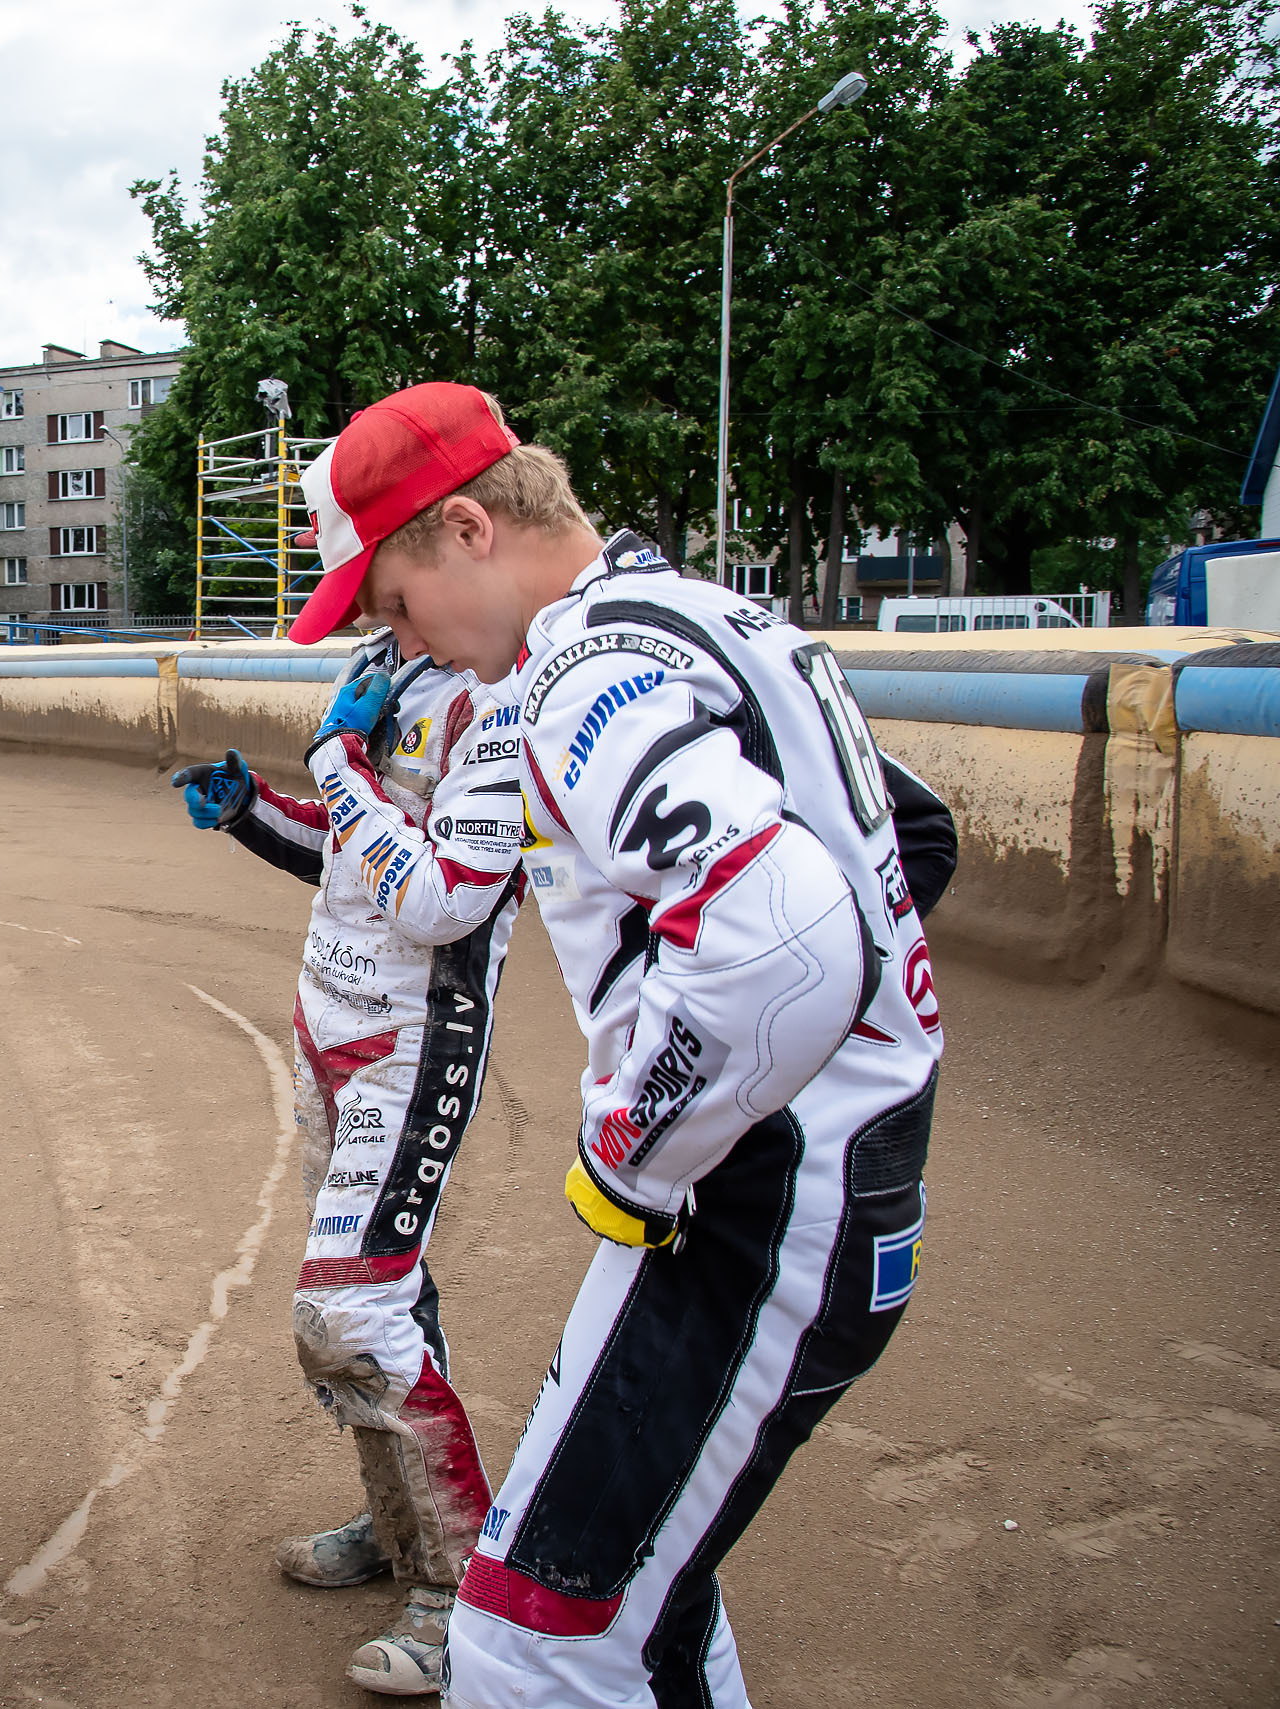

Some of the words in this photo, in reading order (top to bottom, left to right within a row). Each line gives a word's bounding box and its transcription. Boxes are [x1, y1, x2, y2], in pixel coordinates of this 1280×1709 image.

[457, 822, 496, 835] NORTH
[348, 1134, 386, 1145] LATGALE
[349, 1169, 379, 1184] LINE
